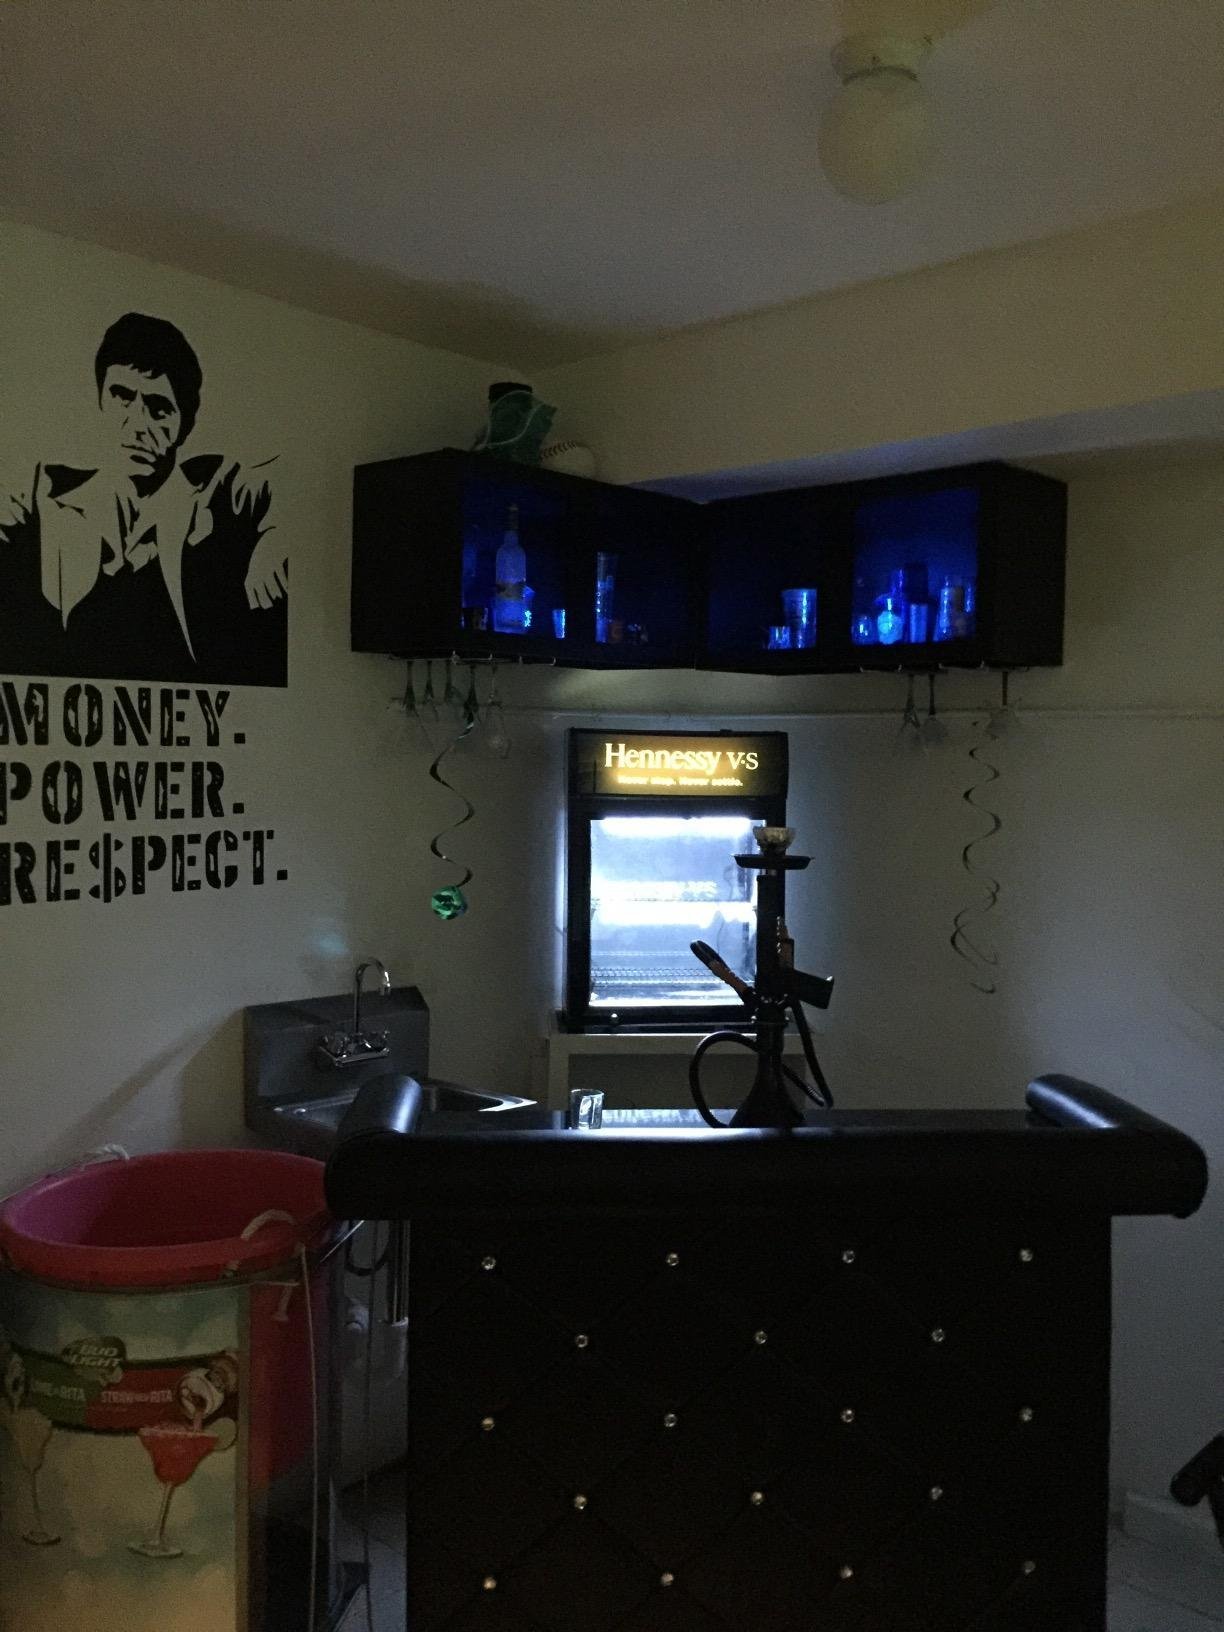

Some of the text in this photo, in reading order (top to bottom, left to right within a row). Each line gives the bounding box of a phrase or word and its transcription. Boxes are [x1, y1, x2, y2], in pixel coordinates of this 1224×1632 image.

[0, 682, 246, 747] MONEY.
[604, 742, 722, 775] Hennessy
[0, 761, 245, 825] POWER.
[0, 830, 288, 906] RE$PECT.
[70, 1354, 121, 1367] LIGHT
